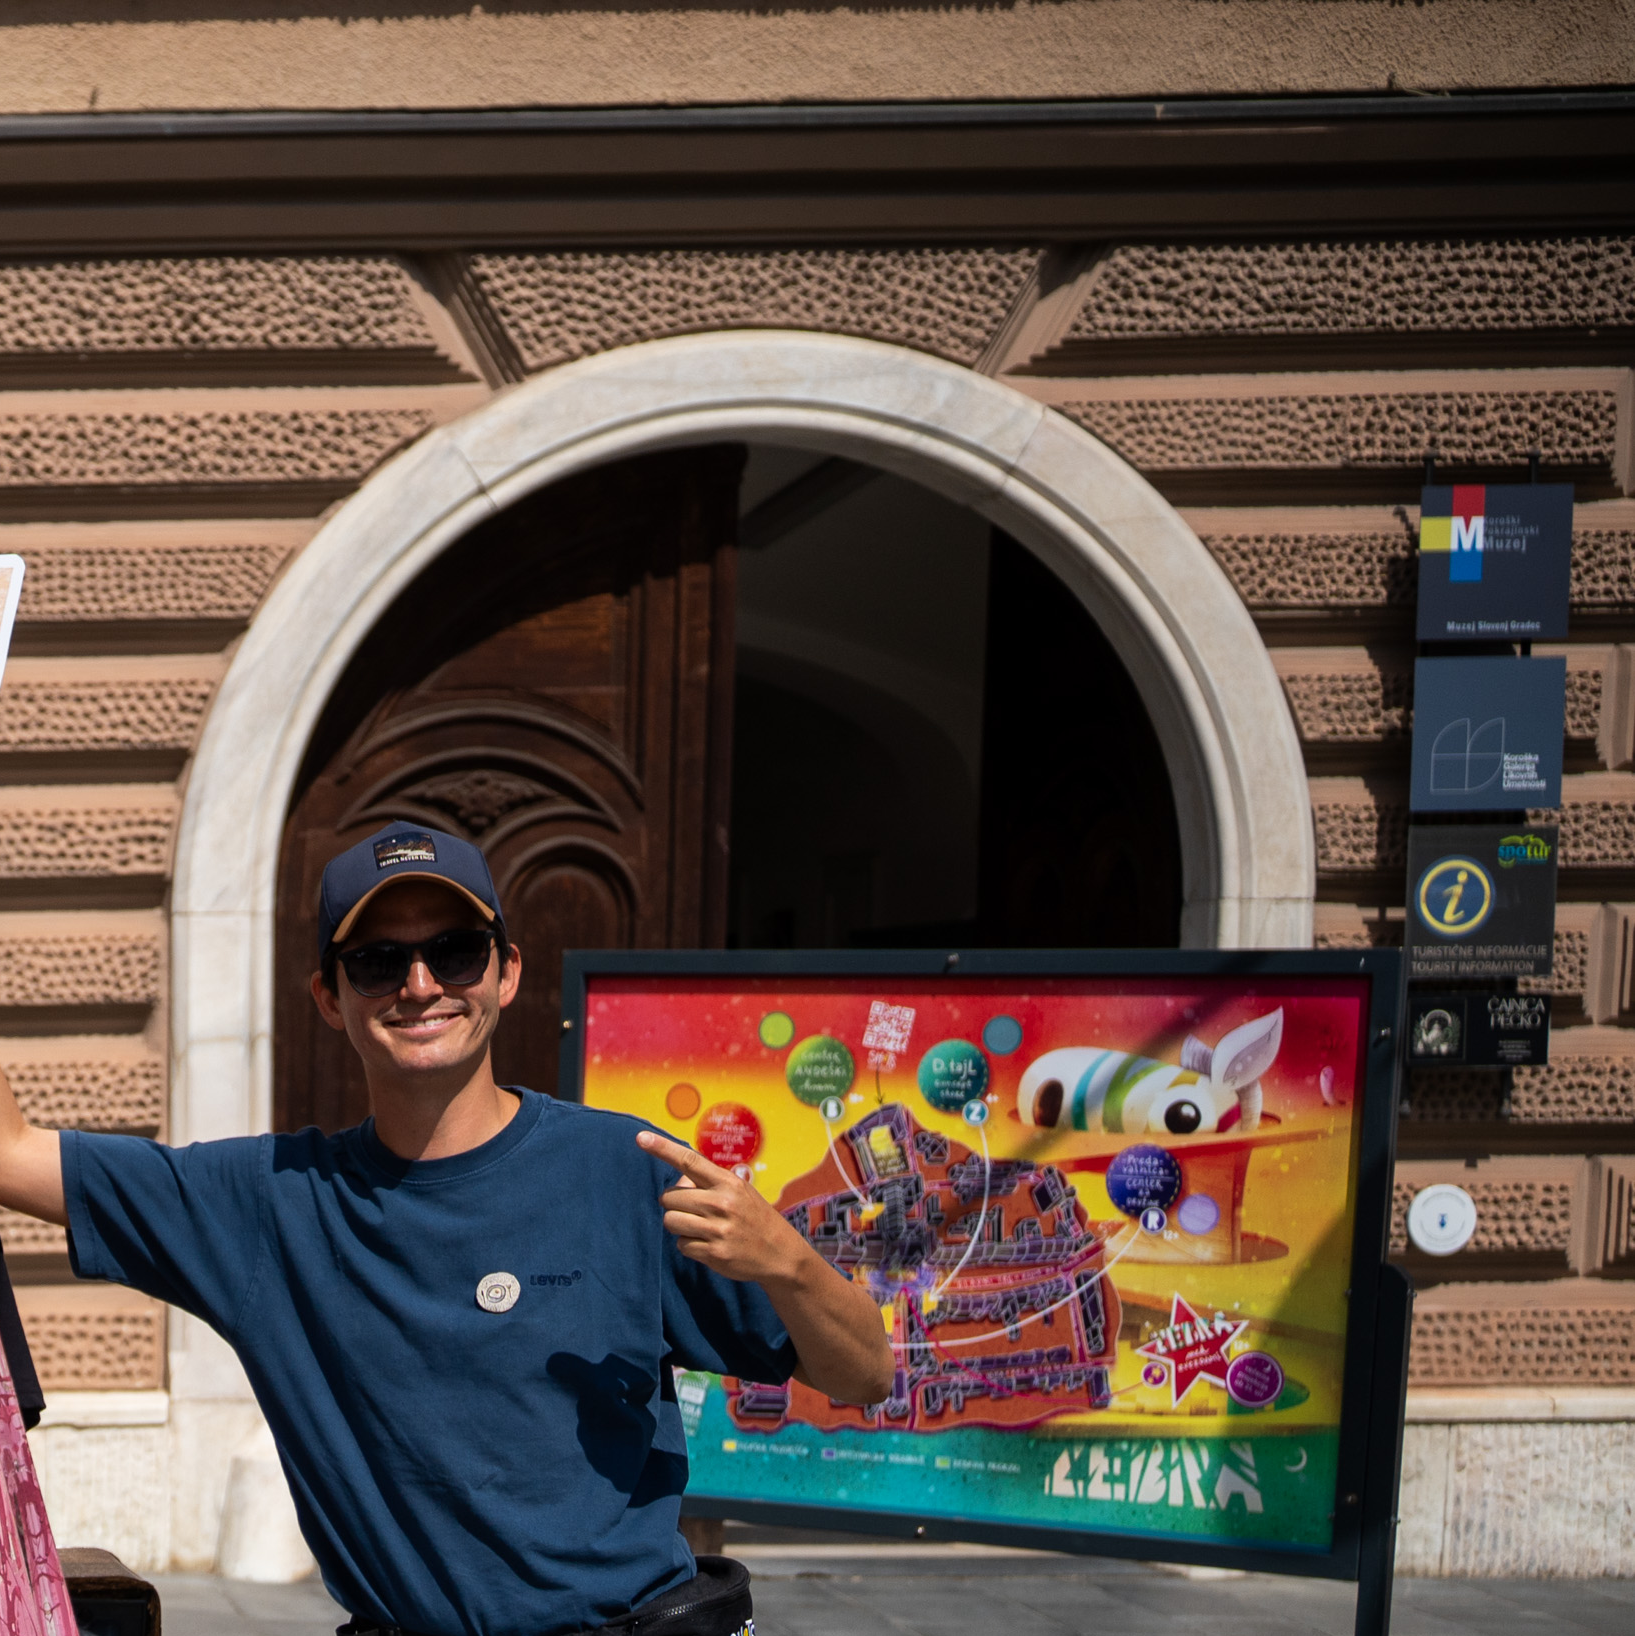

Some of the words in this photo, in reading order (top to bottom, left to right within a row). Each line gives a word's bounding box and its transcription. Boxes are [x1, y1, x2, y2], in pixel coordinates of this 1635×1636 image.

[1483, 536, 1527, 553] Muzej
[1446, 621, 1476, 634] Muzej
[1478, 620, 1508, 633] Slovenj
[1510, 619, 1541, 631] Gradec
[1497, 844, 1552, 860] spotur
[379, 857, 400, 868] TRAVEL
[1412, 943, 1474, 957] TURISTIČNE
[1475, 943, 1548, 957] INFORMACIJE
[1411, 960, 1456, 972] TOURIST
[1458, 959, 1535, 972] INFORMATION
[969, 1102, 982, 1122] Z
[1147, 1210, 1160, 1230] R
[1044, 1439, 1264, 1514] ZEBRA
